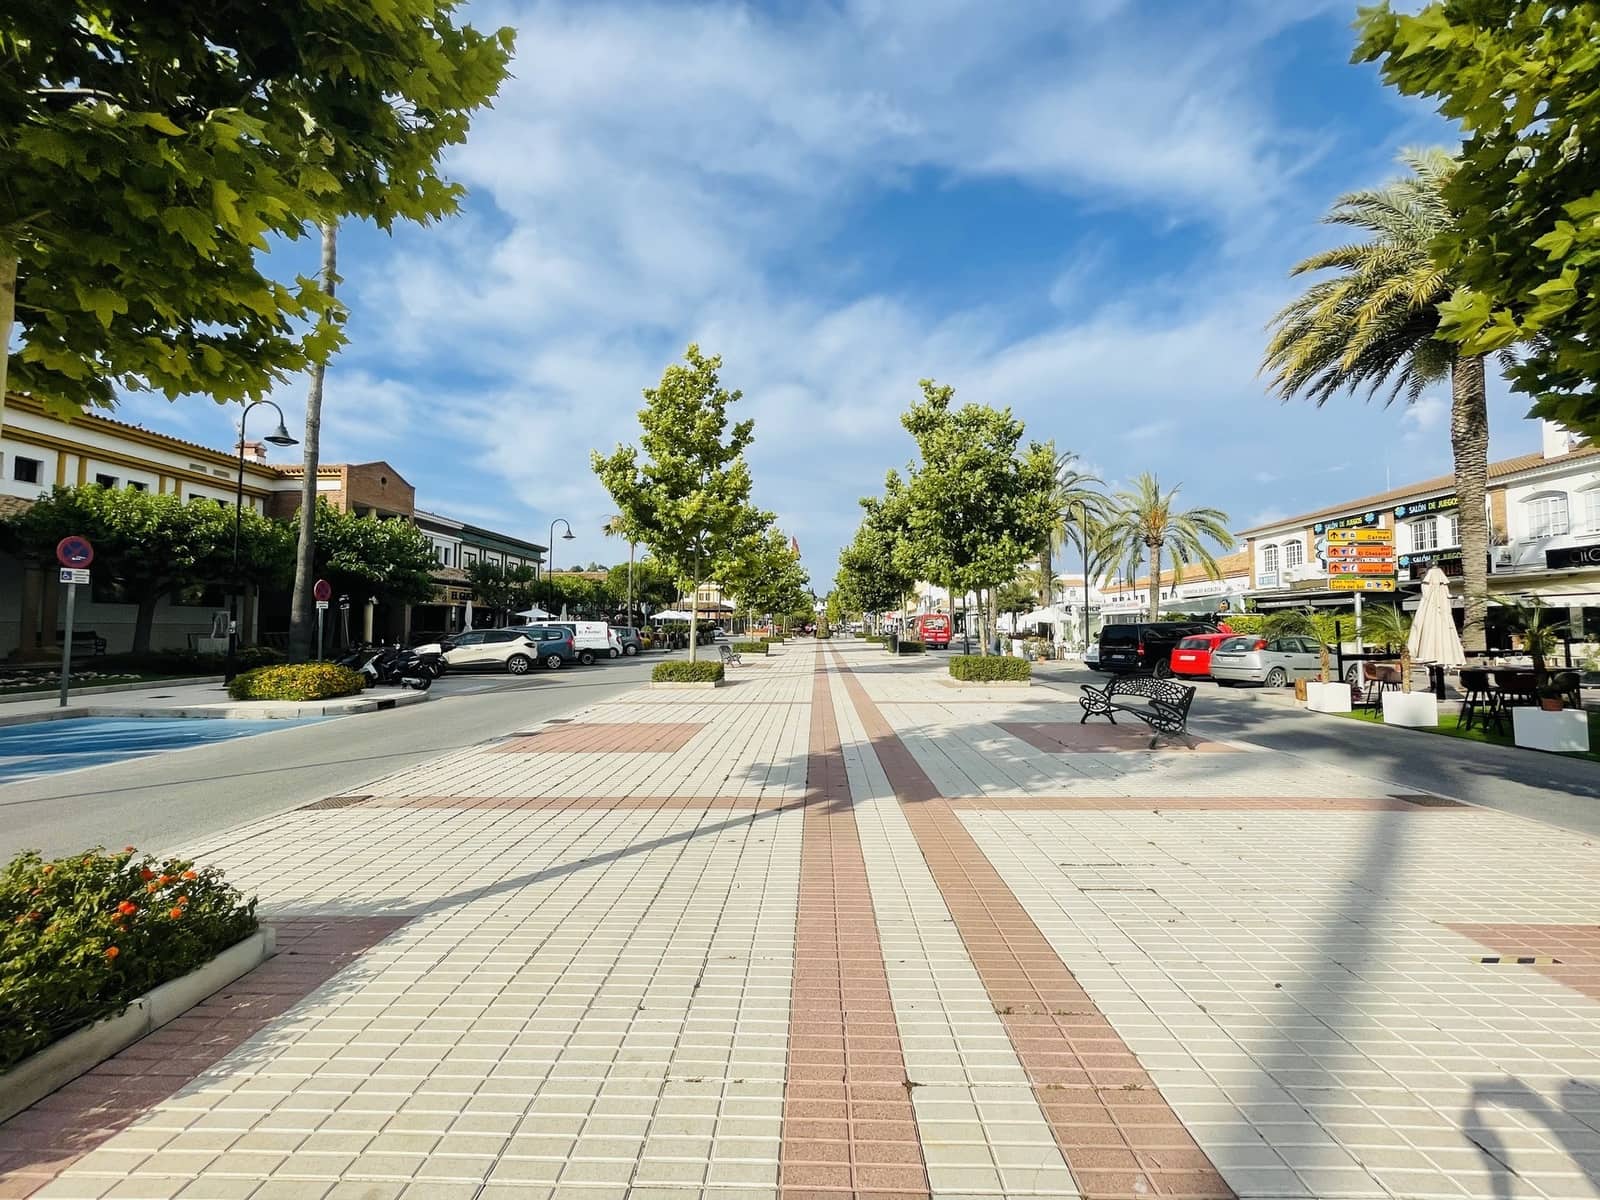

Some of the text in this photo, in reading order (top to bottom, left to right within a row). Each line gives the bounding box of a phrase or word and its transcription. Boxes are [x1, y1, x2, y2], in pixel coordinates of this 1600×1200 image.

[1409, 503, 1427, 514] SALÓN
[1428, 502, 1436, 510] DE
[1339, 520, 1345, 528] DE
[1346, 516, 1363, 527] JUEGOS
